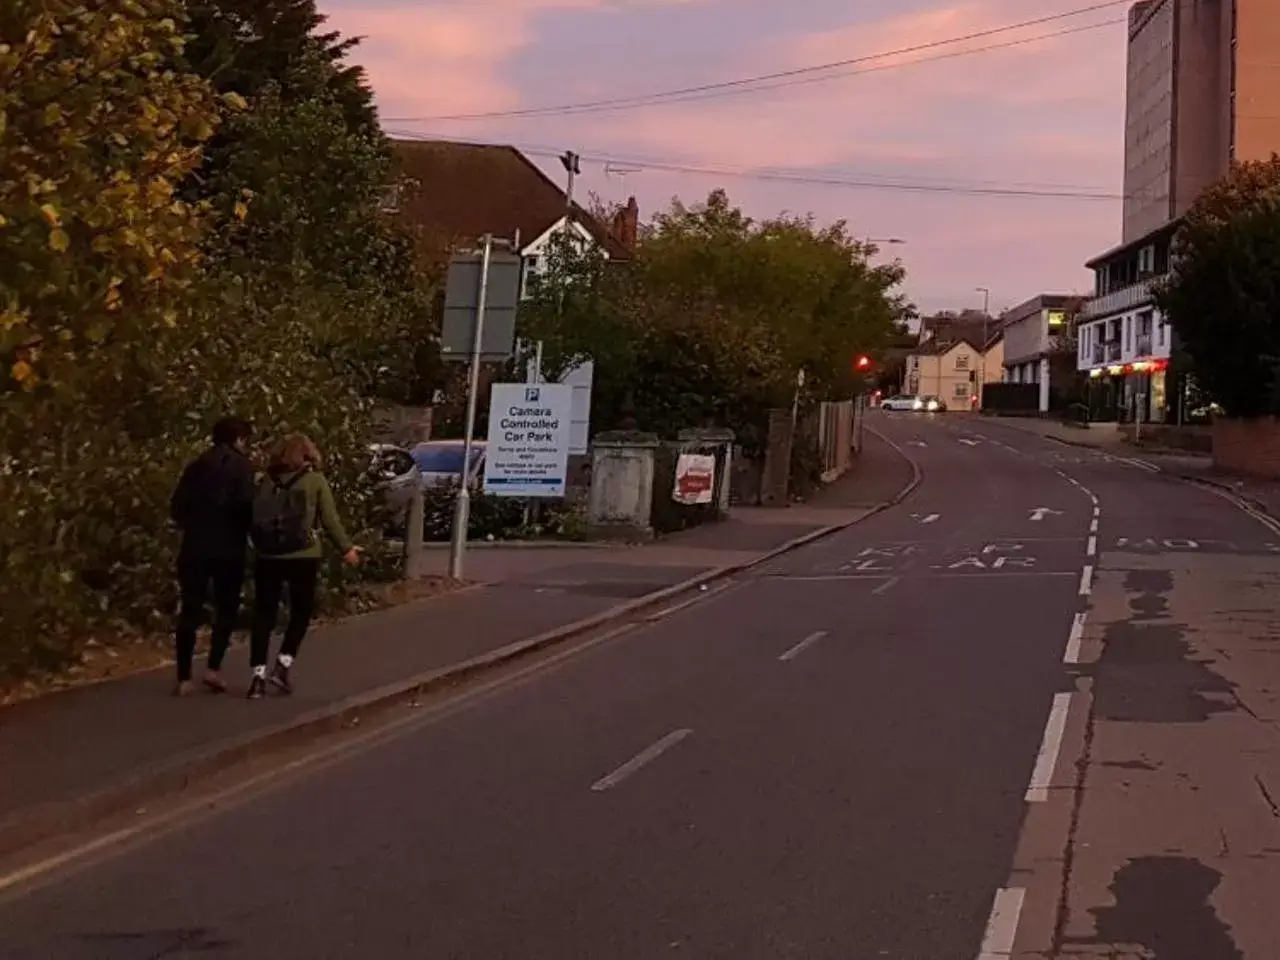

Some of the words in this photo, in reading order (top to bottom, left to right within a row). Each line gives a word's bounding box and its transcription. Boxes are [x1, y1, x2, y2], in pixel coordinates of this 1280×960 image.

[509, 407, 552, 416] Camera
[501, 419, 559, 429] Controlled
[505, 432, 525, 441] Car
[527, 432, 552, 442] Park
